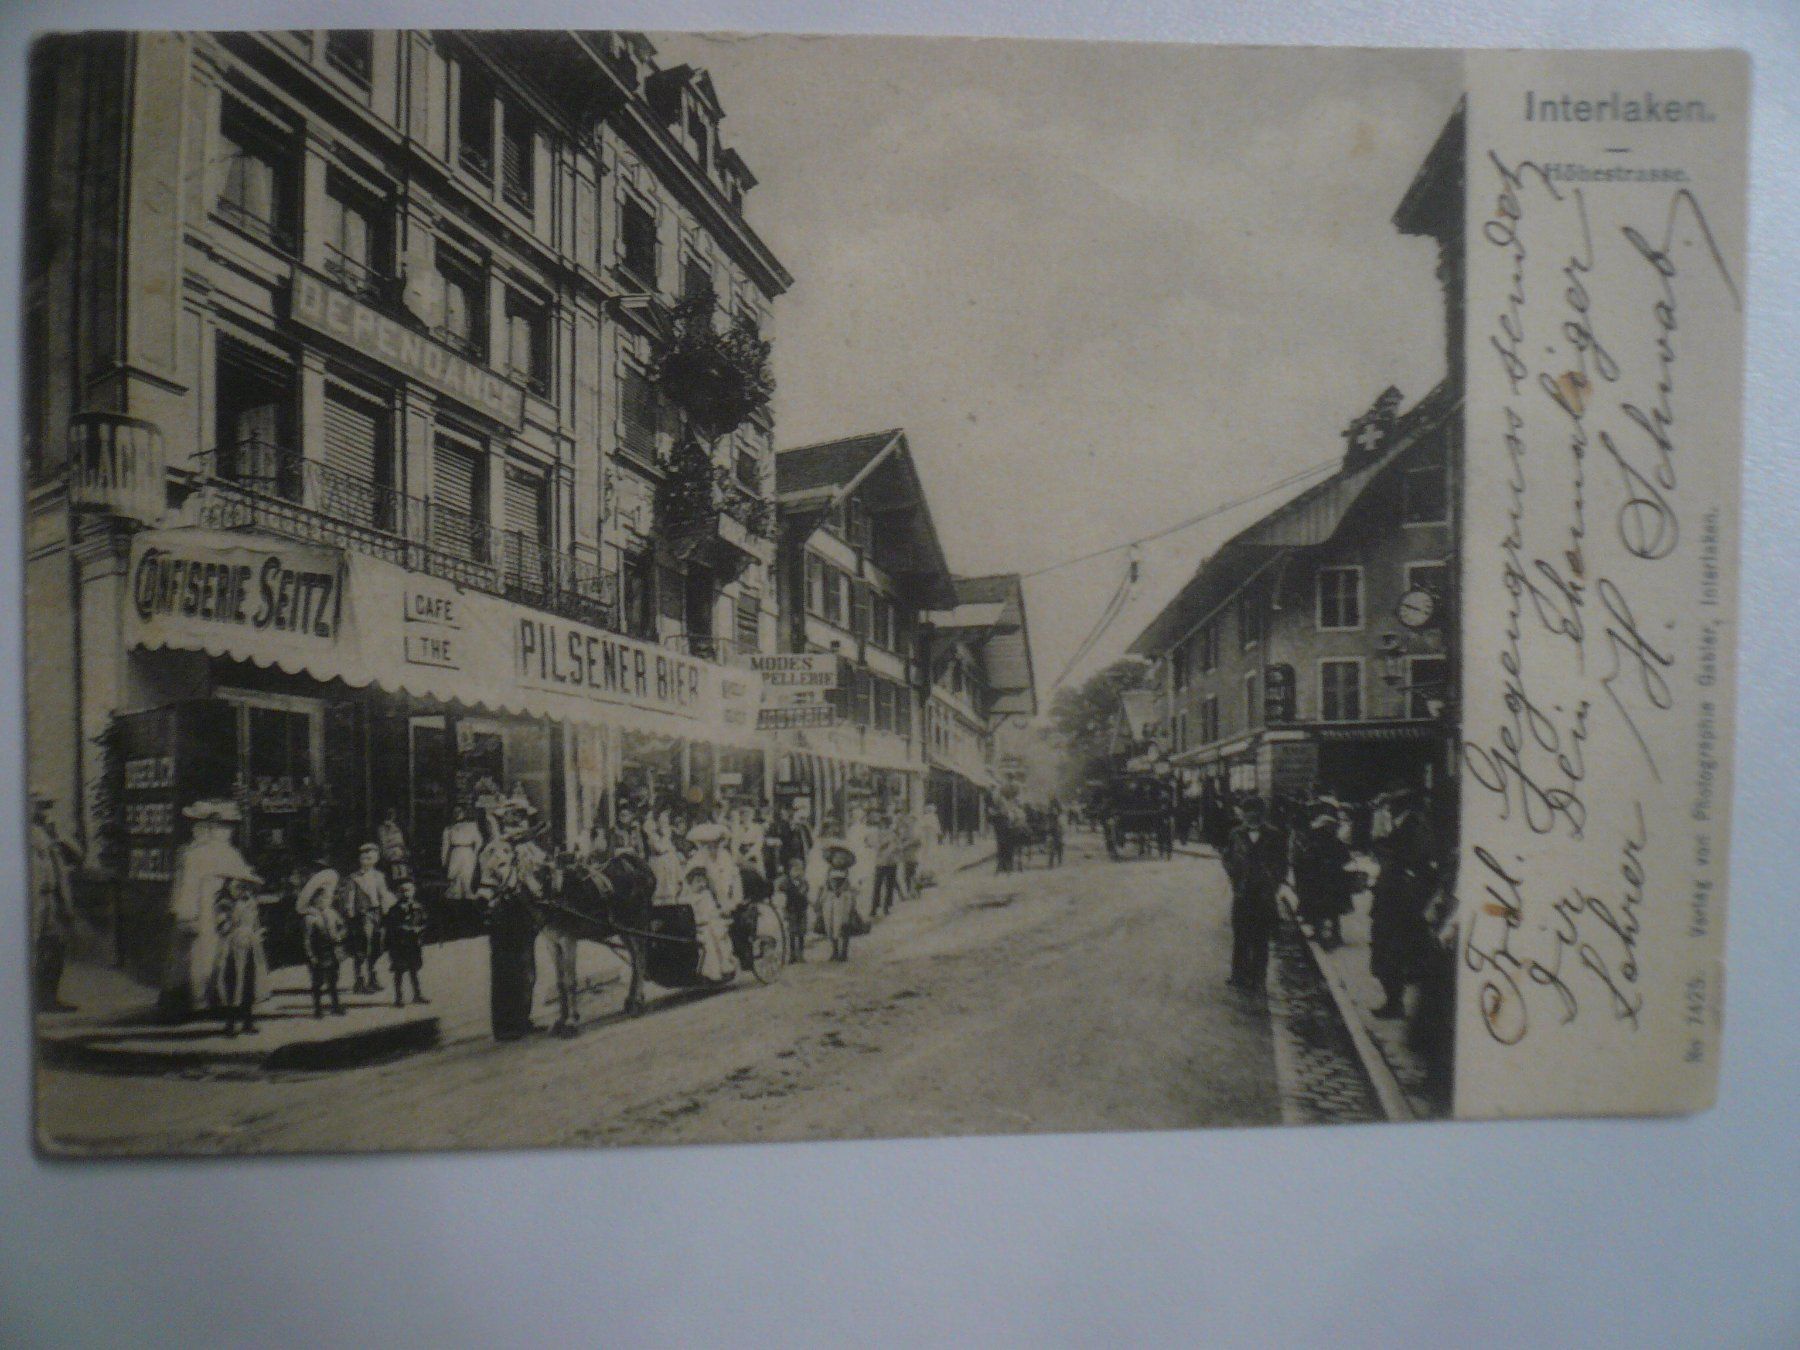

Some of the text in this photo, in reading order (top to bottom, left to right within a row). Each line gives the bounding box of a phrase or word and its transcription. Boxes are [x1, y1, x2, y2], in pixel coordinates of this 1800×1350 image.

[1525, 91, 1717, 122] Interlaken.
[520, 617, 700, 705] PILSENER BIER
[1692, 702, 1718, 822] Photographie
[1687, 880, 1714, 938] Verlag
